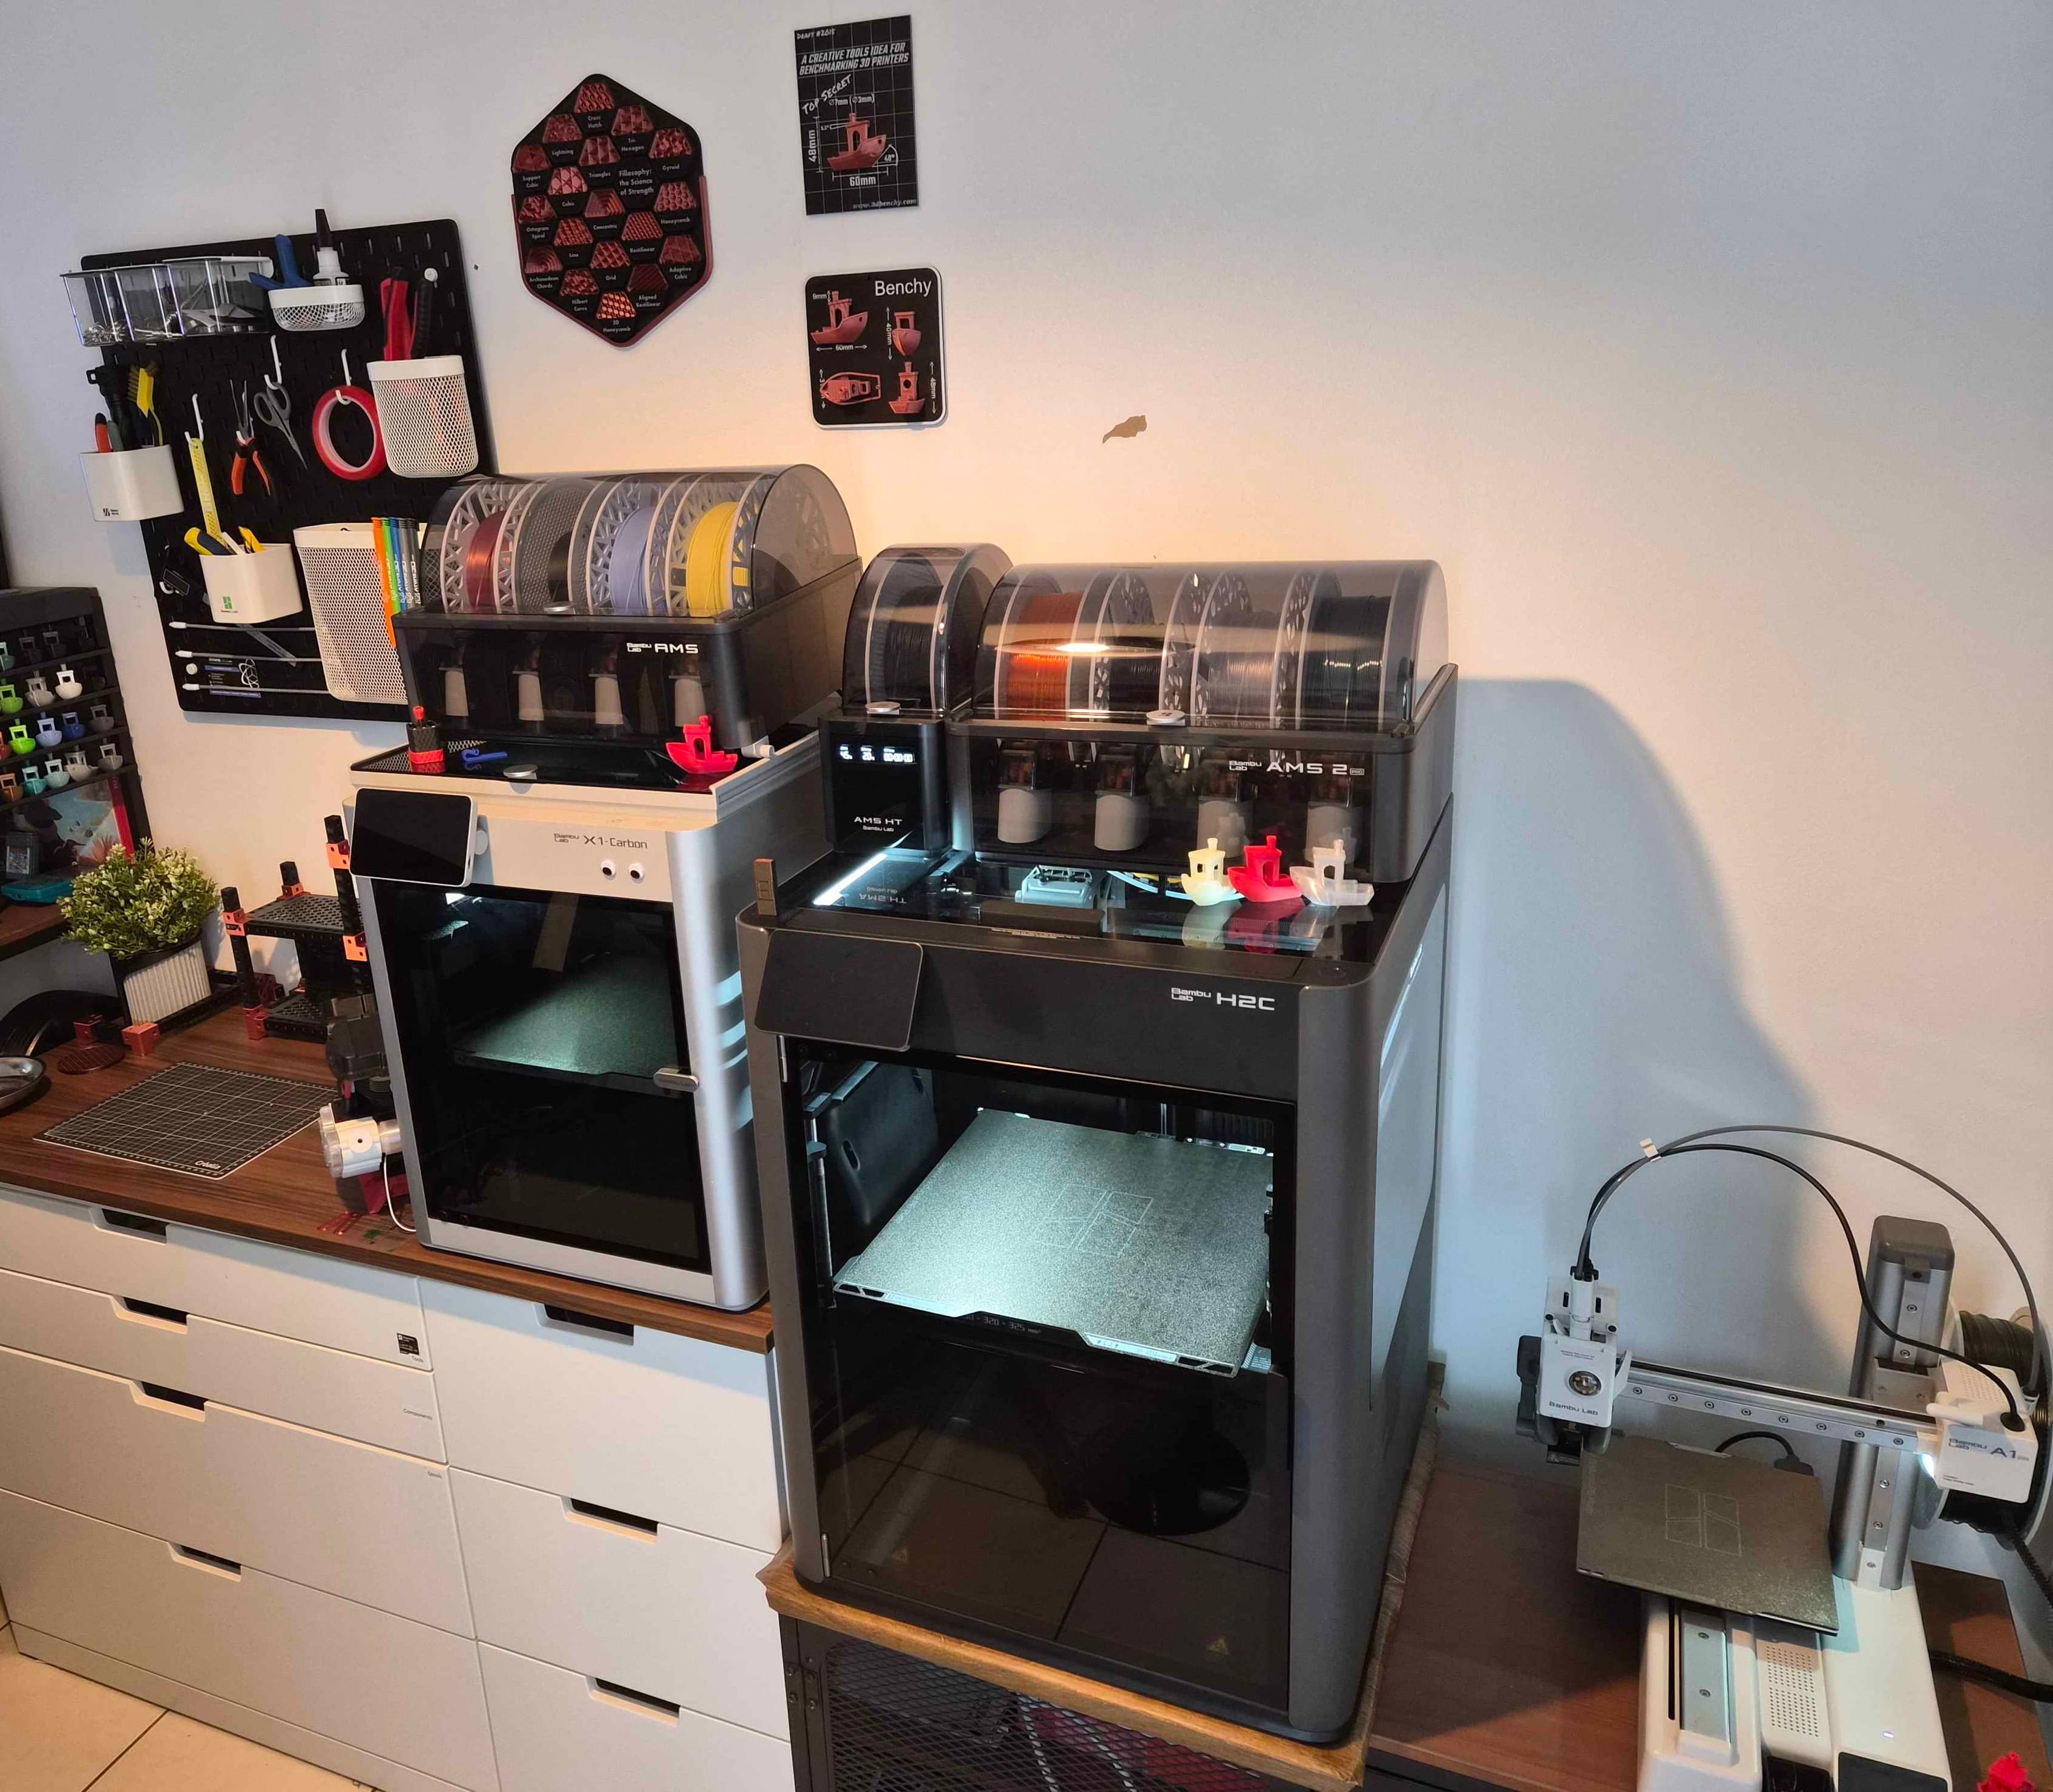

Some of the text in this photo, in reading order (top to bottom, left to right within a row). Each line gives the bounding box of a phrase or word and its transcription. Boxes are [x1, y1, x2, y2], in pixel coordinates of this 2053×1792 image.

[801, 42, 906, 65] A CREATIVE TOOLS IDEA FOR
[800, 53, 909, 75] BENCHMARKING 3D PRINTERS
[802, 74, 852, 114] TOP SECRET
[808, 130, 817, 162] 48mm
[849, 176, 876, 186] 60mm
[875, 278, 931, 297] Benchy
[654, 643, 698, 654] AMS
[1266, 762, 1322, 774] AMS
[1332, 764, 1347, 775] 2
[1171, 987, 1211, 998] Bambu
[1217, 993, 1275, 1011] H2C
[1008, 1321, 1025, 1331] 325
[1549, 1400, 1580, 1411] Bambu
[1950, 1438, 1988, 1449] Bambu
[1990, 1447, 2016, 1459] A1
